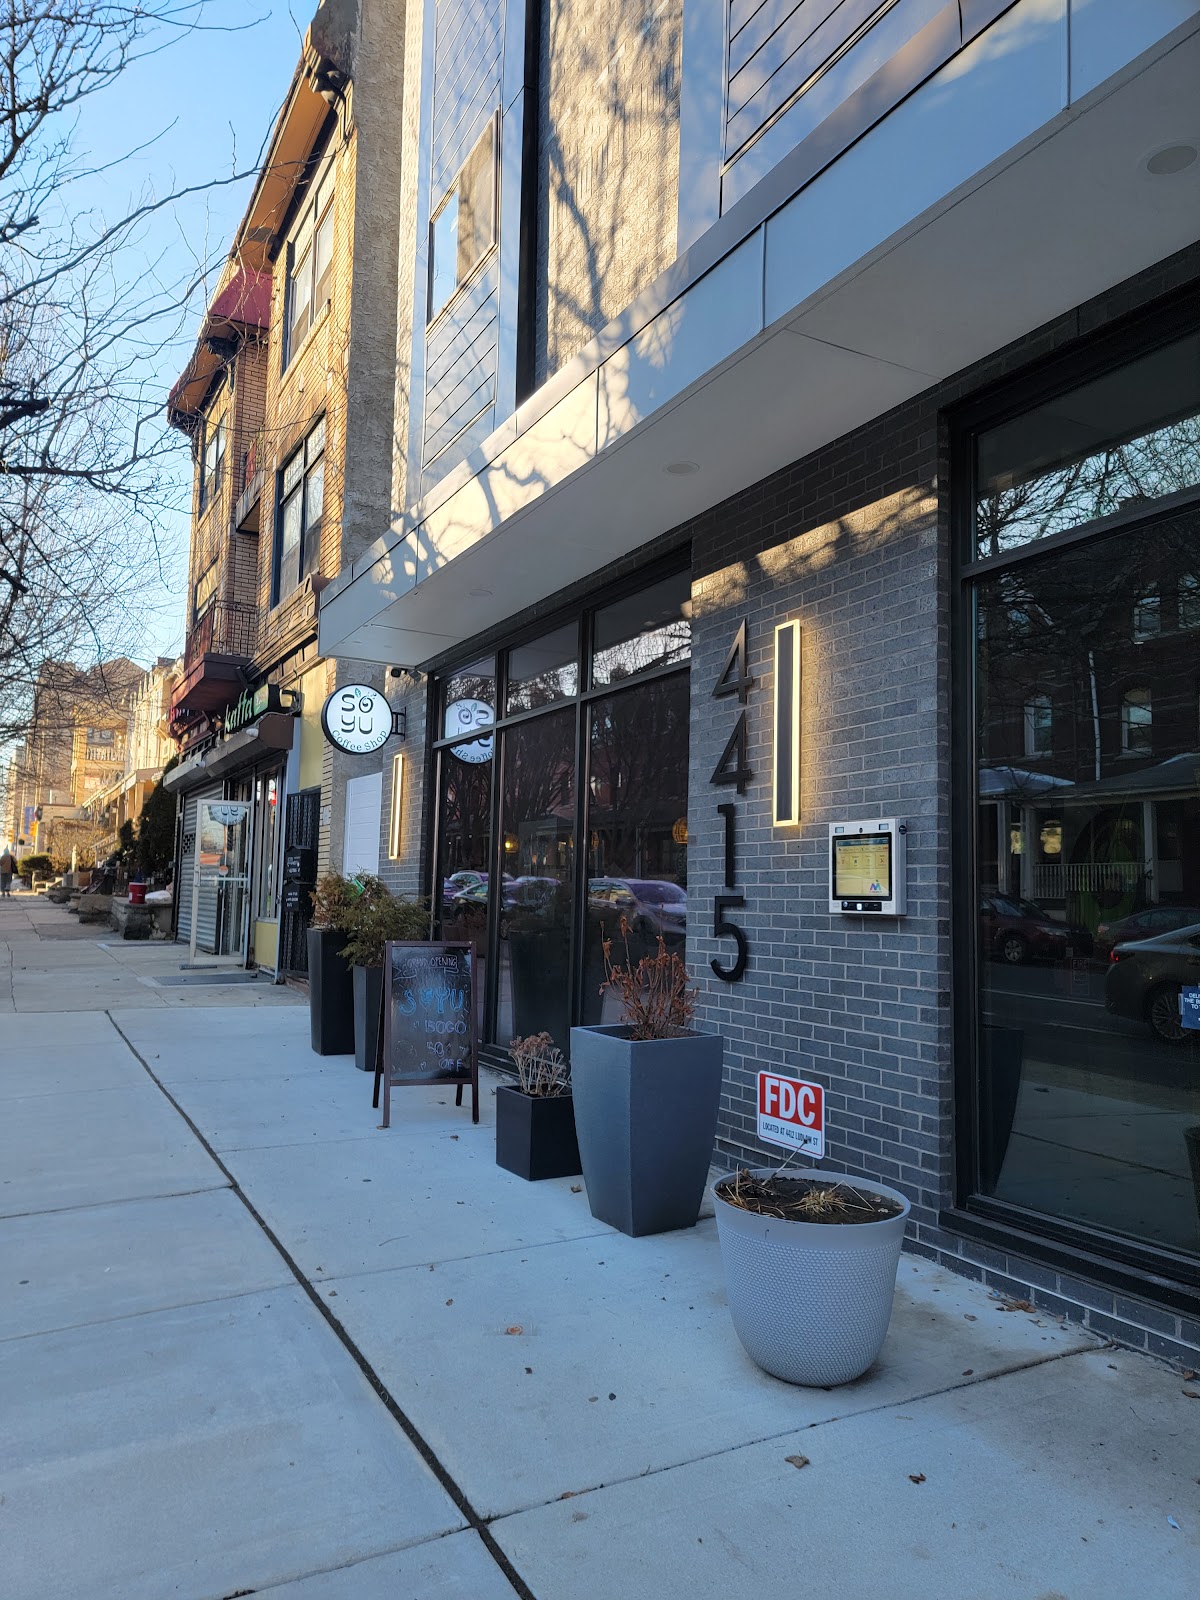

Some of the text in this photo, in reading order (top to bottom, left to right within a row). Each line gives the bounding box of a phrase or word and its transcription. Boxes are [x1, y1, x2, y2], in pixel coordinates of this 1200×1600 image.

[332, 729, 387, 752] Coffee Shop
[709, 617, 752, 982] 4415
[430, 956, 457, 968] OPENING
[425, 1020, 467, 1035] BOGO
[439, 1058, 463, 1072] OFF
[765, 1076, 816, 1126] FDC
[762, 1121, 780, 1134] LOCATED
[780, 1127, 785, 1136] AT
[812, 1137, 818, 1147] ST
